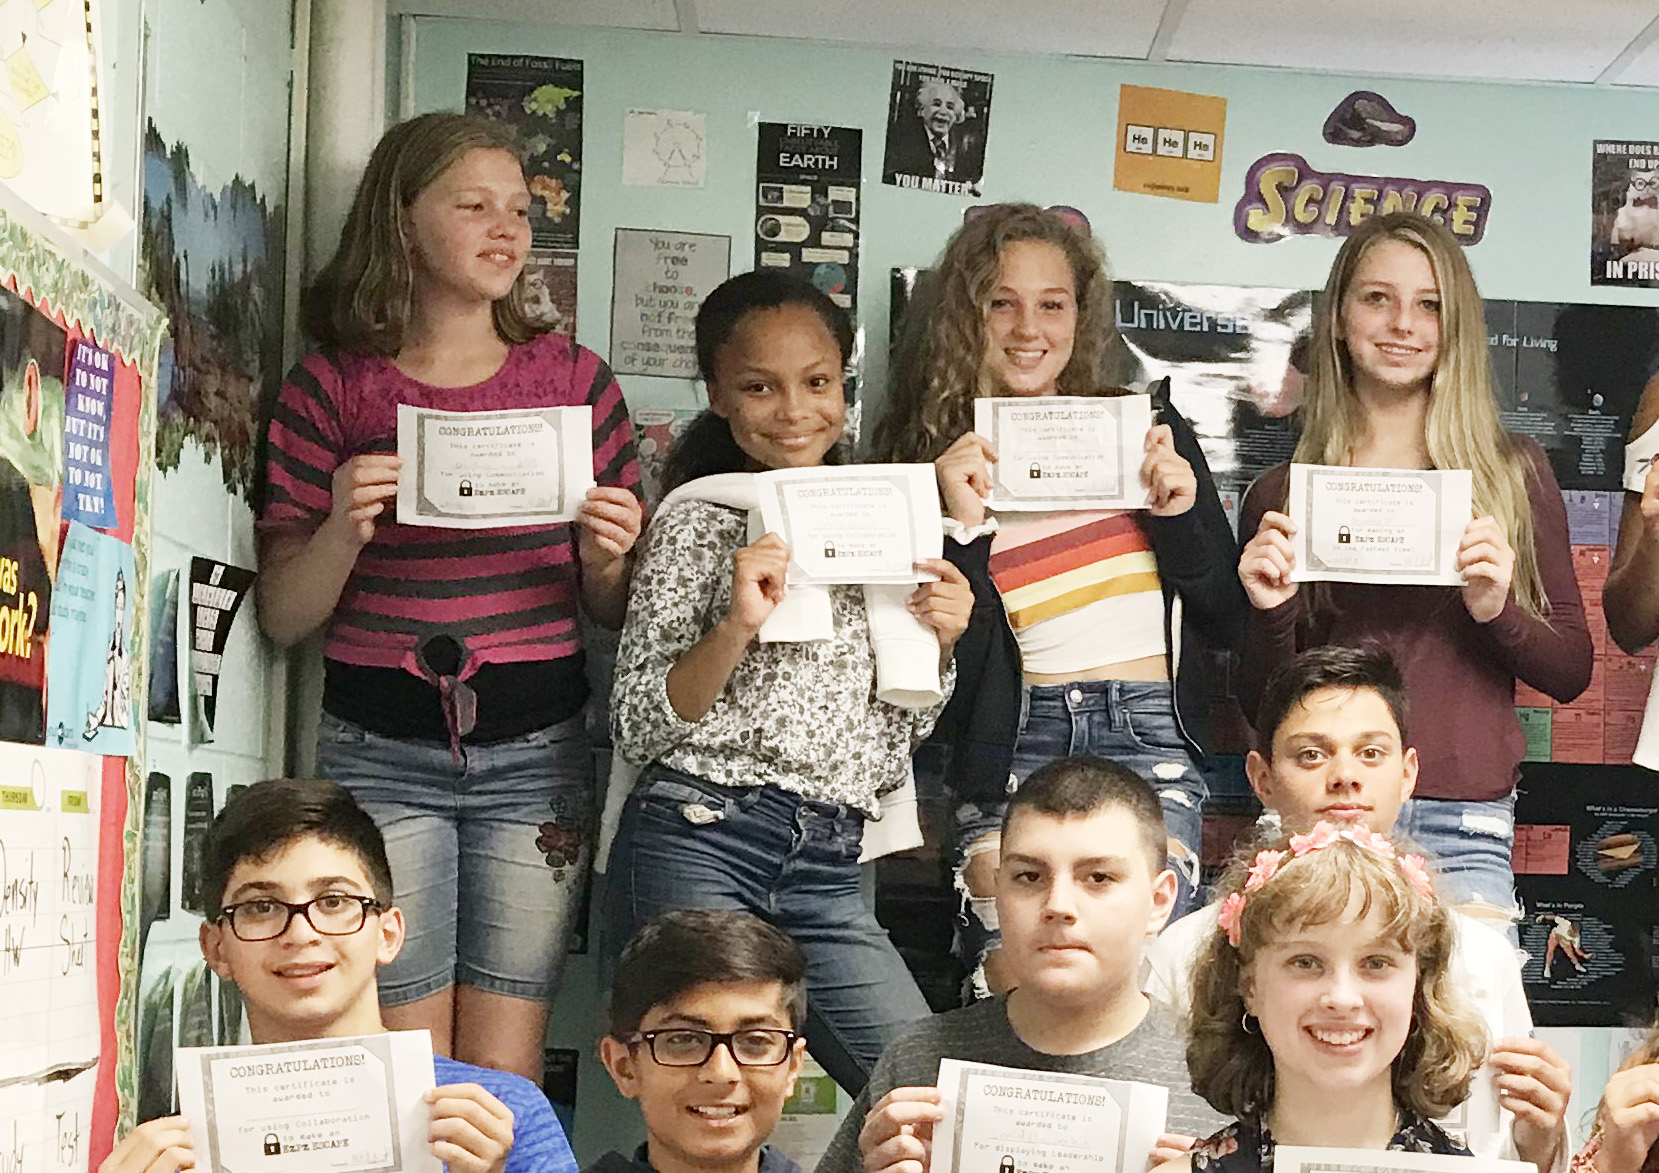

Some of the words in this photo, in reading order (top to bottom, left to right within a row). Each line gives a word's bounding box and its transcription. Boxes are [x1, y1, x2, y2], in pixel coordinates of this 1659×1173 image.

[491, 56, 511, 67] End
[512, 57, 524, 67] of
[787, 124, 832, 139] FIFTY
[1132, 133, 1149, 145] He
[1163, 136, 1179, 149] He
[1193, 140, 1210, 152] He
[1596, 143, 1627, 155] WHERE
[1629, 144, 1651, 155] DOES
[779, 152, 838, 170] EARTH
[1629, 159, 1646, 169] END
[894, 172, 920, 188] YOU
[921, 176, 970, 197] MATTER
[1246, 165, 1482, 236] SCIENCE
[649, 236, 670, 251] You
[674, 241, 697, 253] are
[664, 266, 679, 280] to
[1606, 260, 1623, 279] IN
[634, 294, 656, 309] but
[658, 298, 679, 313] you
[1115, 299, 1250, 335] Universe
[1502, 334, 1520, 348] for
[1523, 335, 1560, 352] Living
[77, 342, 93, 366] IT'S
[95, 350, 109, 372] OK
[623, 355, 637, 366] of
[641, 357, 669, 372] your
[75, 368, 88, 389] TO
[89, 373, 109, 396] NOT
[77, 393, 107, 423] KNOW,
[1010, 410, 1105, 422] CONGRATULATIONS!
[65, 415, 87, 437] BUT
[88, 419, 105, 443] IT'S
[438, 424, 545, 437] CONGRATULATIONS!
[68, 441, 89, 464] NOT
[90, 446, 103, 467] OK
[68, 466, 83, 485] TO
[84, 471, 103, 491] NOT
[1325, 481, 1423, 493] CONGRATULATIONS!
[797, 486, 893, 498] CONGRATULATIONS!
[77, 493, 105, 515] TRY!
[0, 590, 38, 659] ork?
[230, 1053, 366, 1079] CONGRATULATIONS!
[244, 1085, 268, 1096] This
[274, 1078, 338, 1092] certificate
[344, 1076, 356, 1086] is
[983, 1083, 1106, 1107] CONGRATULATIONS!
[261, 1121, 290, 1134] using
[295, 1113, 371, 1129] Collaboration
[55, 1111, 80, 1168] Test
[312, 1138, 350, 1153] ESCAPE
